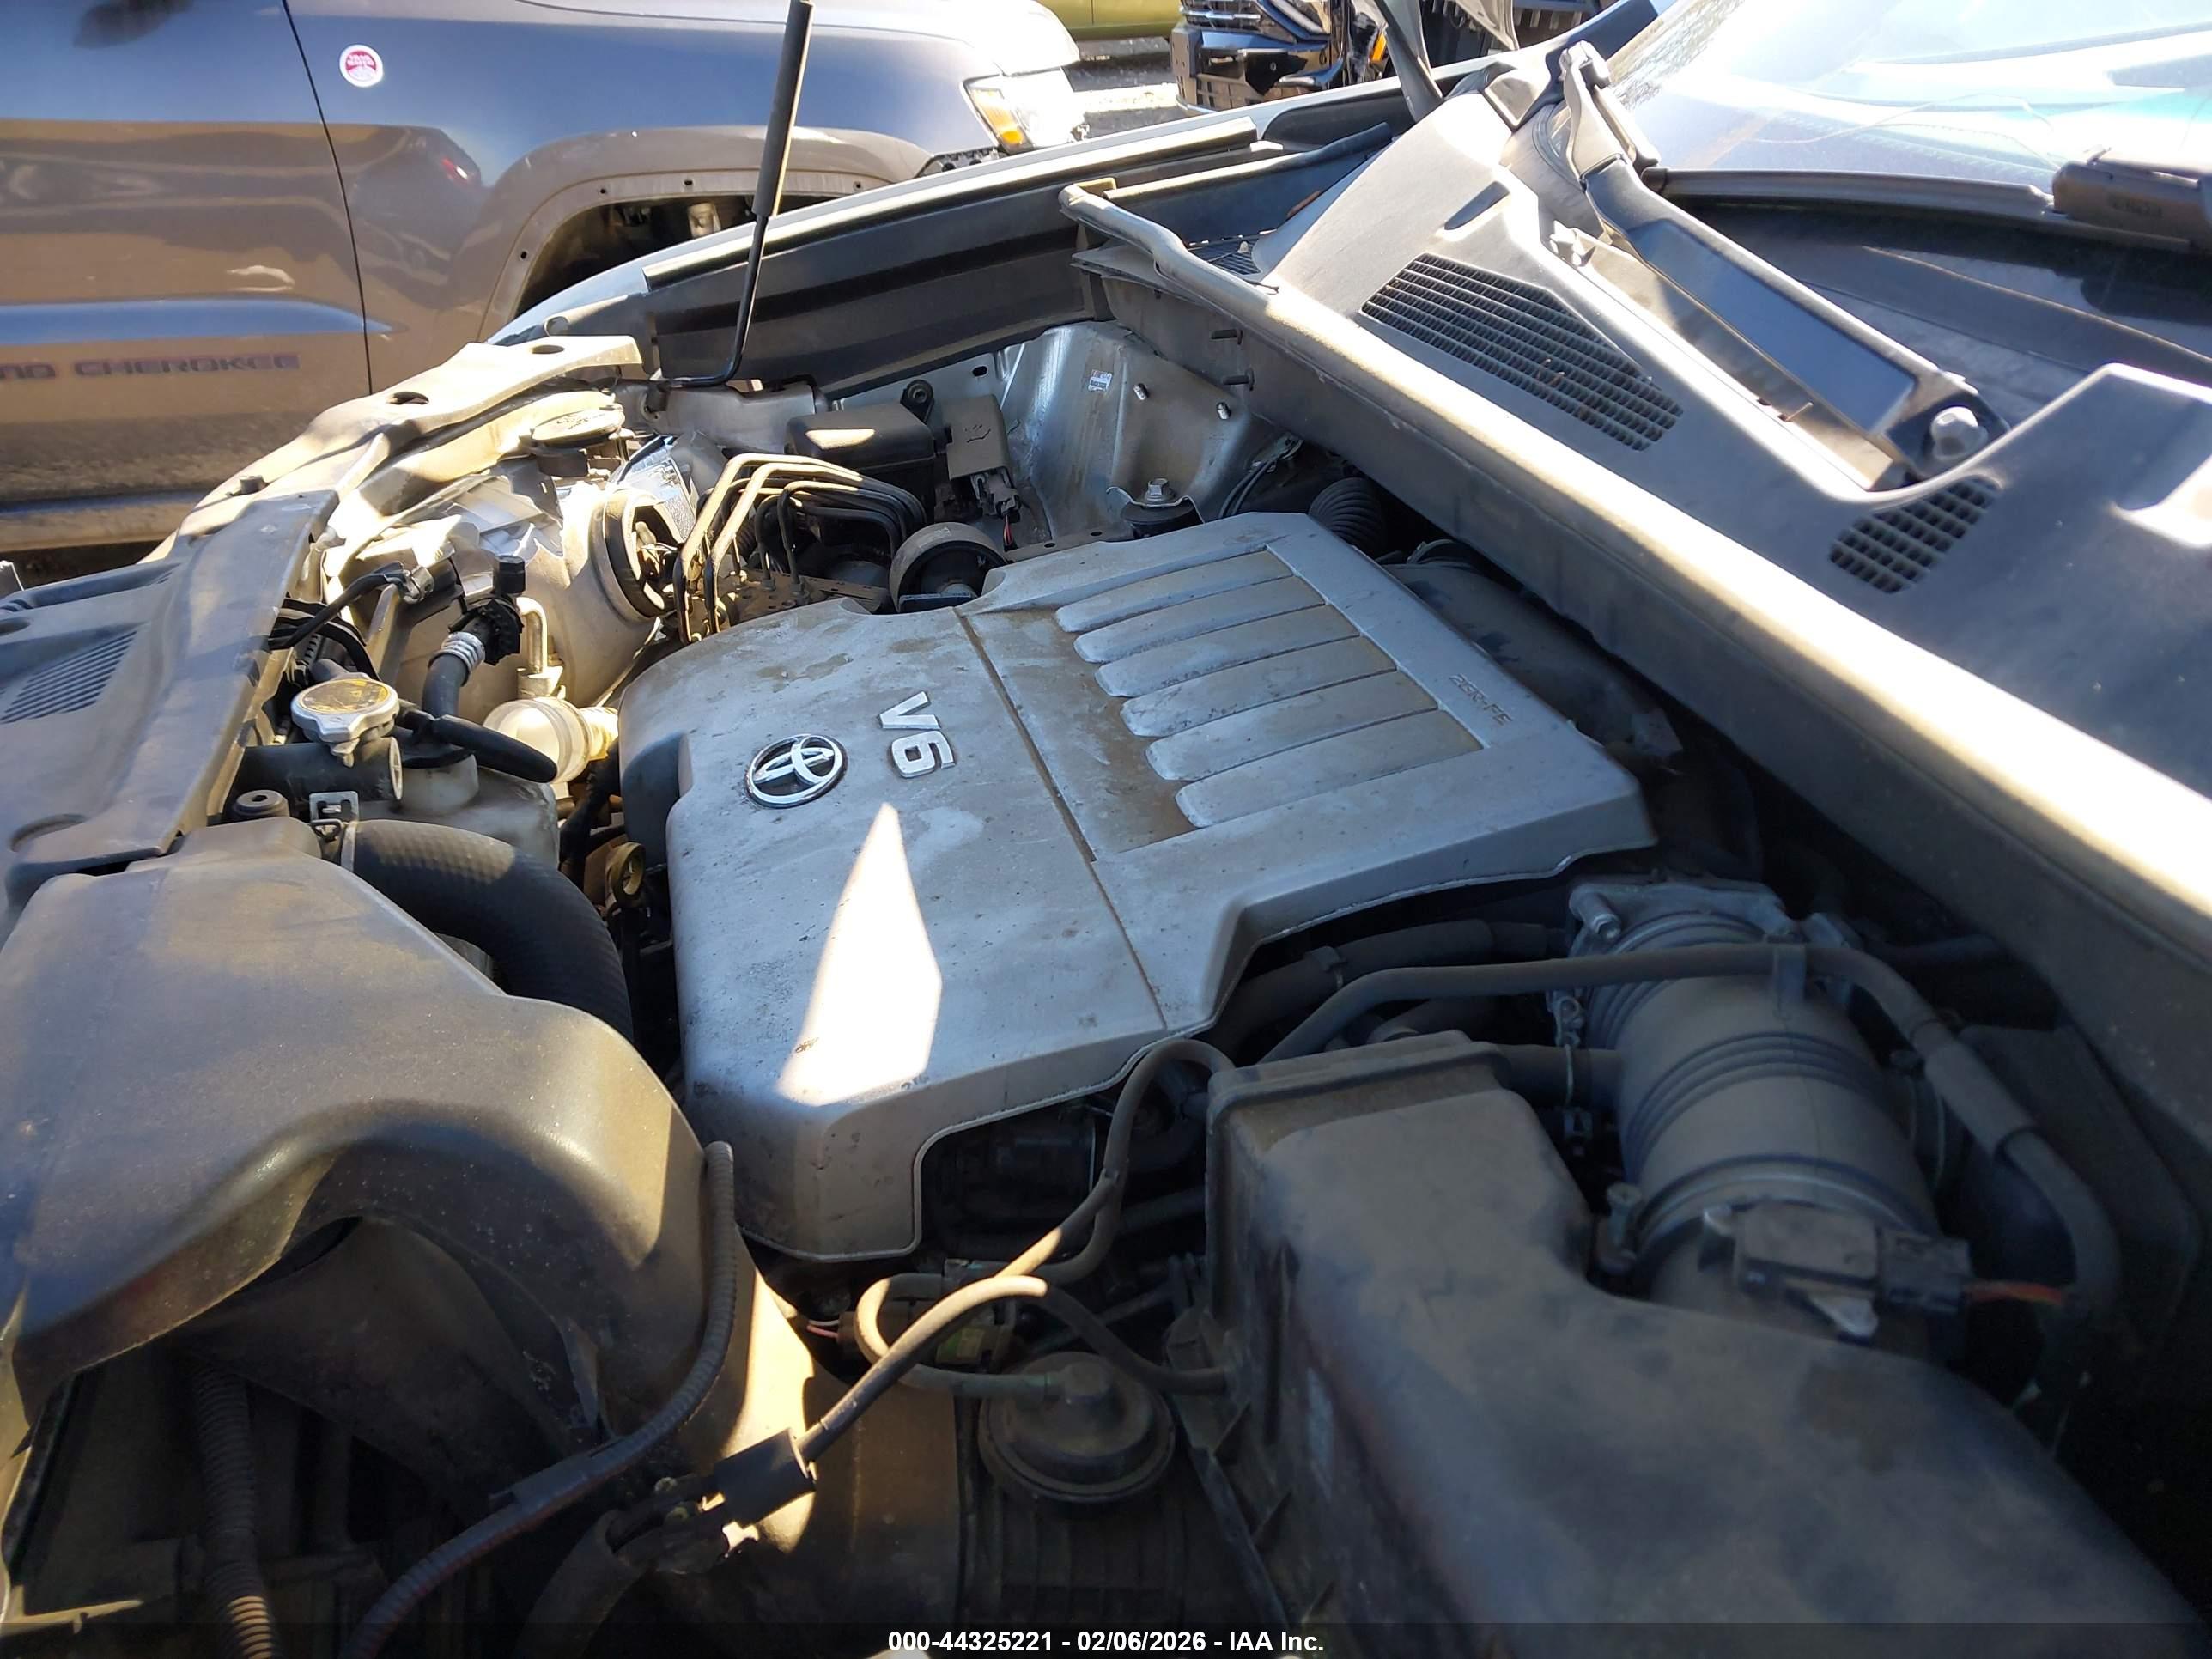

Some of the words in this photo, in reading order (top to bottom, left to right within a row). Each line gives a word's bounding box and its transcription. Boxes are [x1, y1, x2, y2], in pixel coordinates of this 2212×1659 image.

[74, 355, 299, 376] CHEROKEE
[1449, 672, 1513, 726] 2GR-FE
[878, 690, 957, 779] V6
